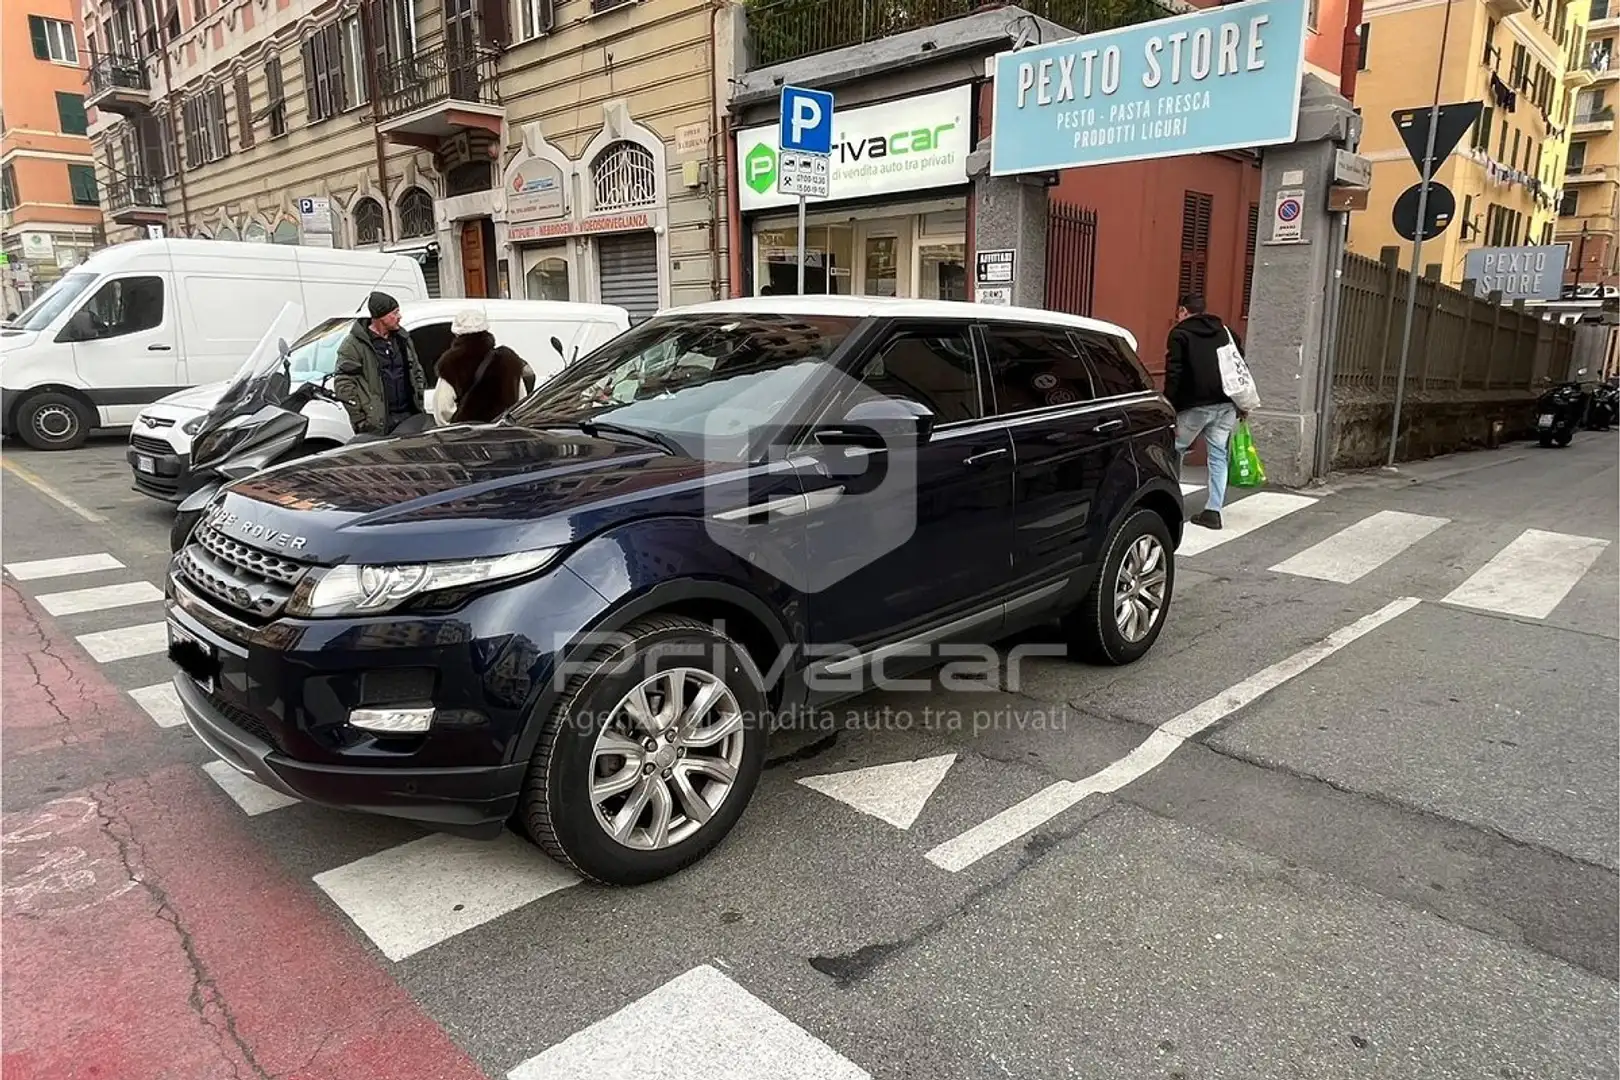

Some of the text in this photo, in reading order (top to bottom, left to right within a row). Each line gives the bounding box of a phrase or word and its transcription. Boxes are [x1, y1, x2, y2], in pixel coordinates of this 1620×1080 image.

[1016, 14, 1270, 109] PEXTO STORE
[791, 96, 822, 143] P
[1057, 110, 1095, 130] PESTO
[1109, 99, 1151, 123] PASTA
[1158, 90, 1211, 115] FRESCA
[1073, 117, 1188, 148] PRODOTTI LIGURI
[751, 155, 774, 181] P
[844, 161, 879, 180] vendita
[880, 161, 903, 175] auto
[904, 158, 919, 171] tra
[920, 152, 955, 172] privati
[302, 200, 311, 213] P
[1483, 252, 1546, 273] PEXTO
[1481, 273, 1544, 294] STORE
[241, 520, 307, 550] ROVER
